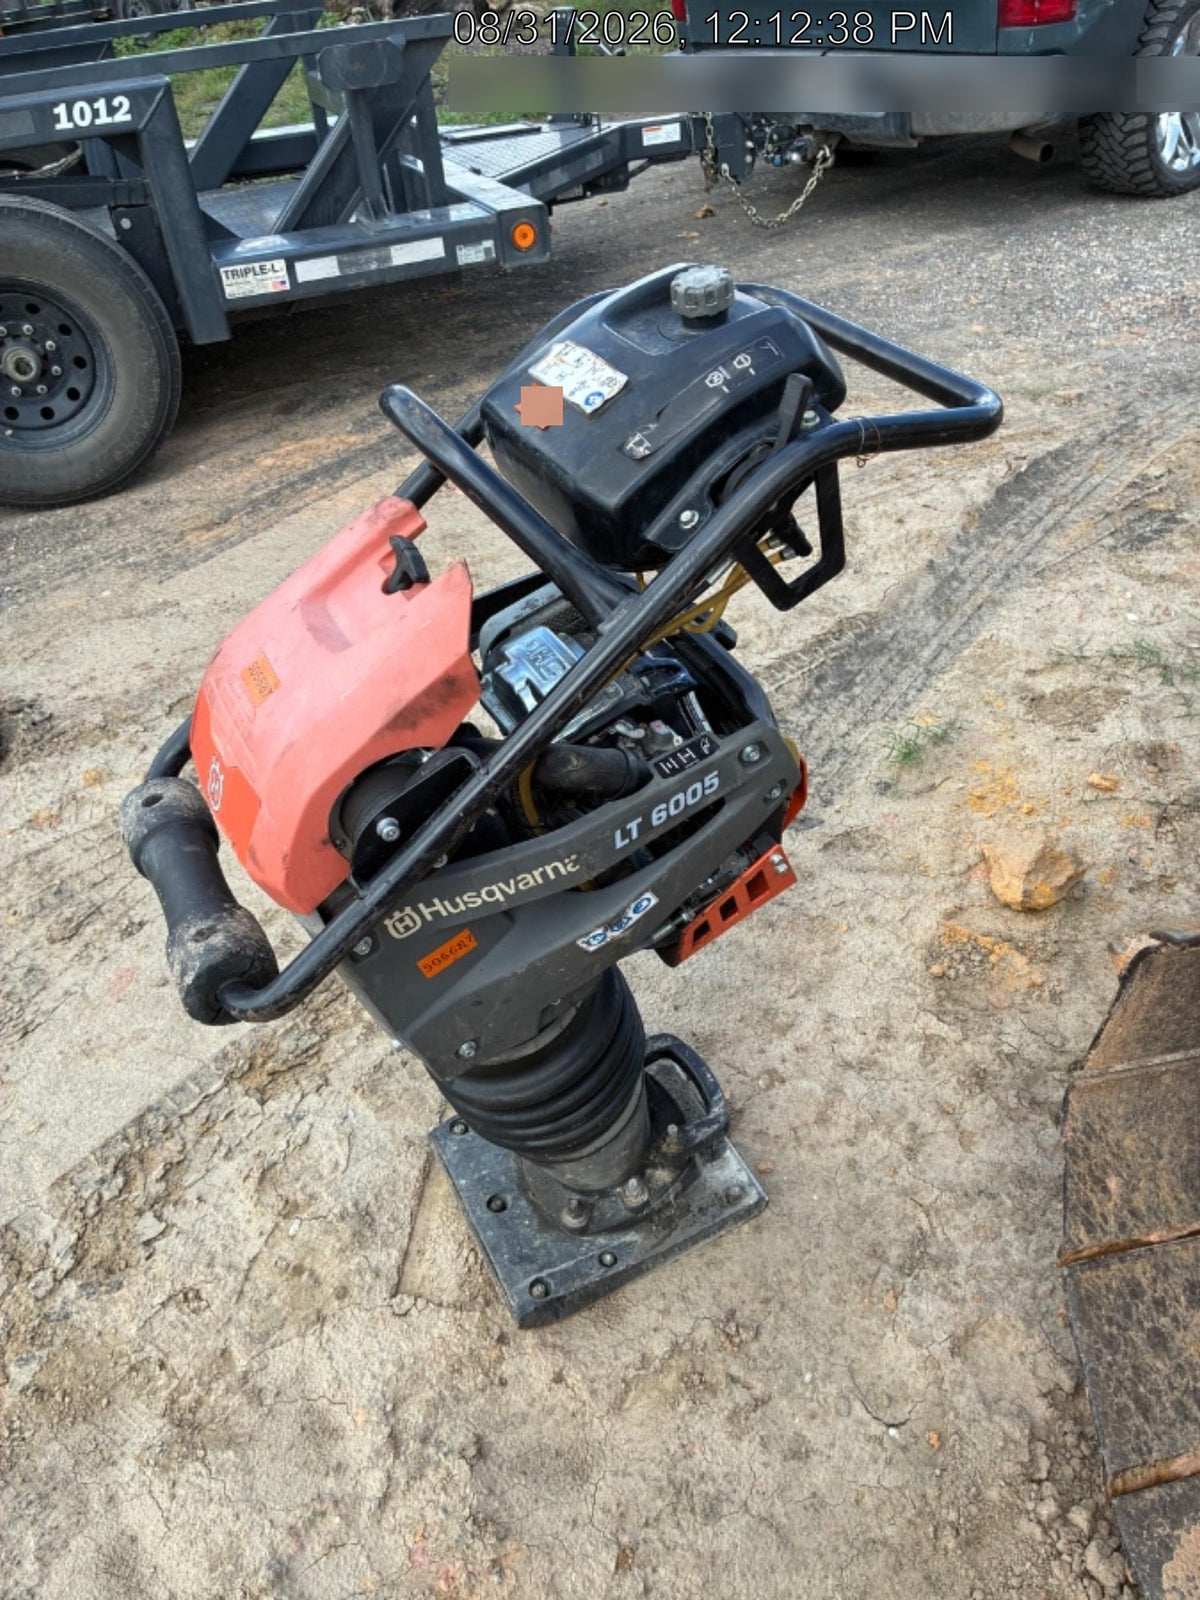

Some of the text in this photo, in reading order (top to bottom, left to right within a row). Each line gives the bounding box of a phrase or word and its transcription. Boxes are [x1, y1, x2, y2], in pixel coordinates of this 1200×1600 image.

[53, 95, 132, 130] 1012
[614, 770, 720, 850] LT 6005
